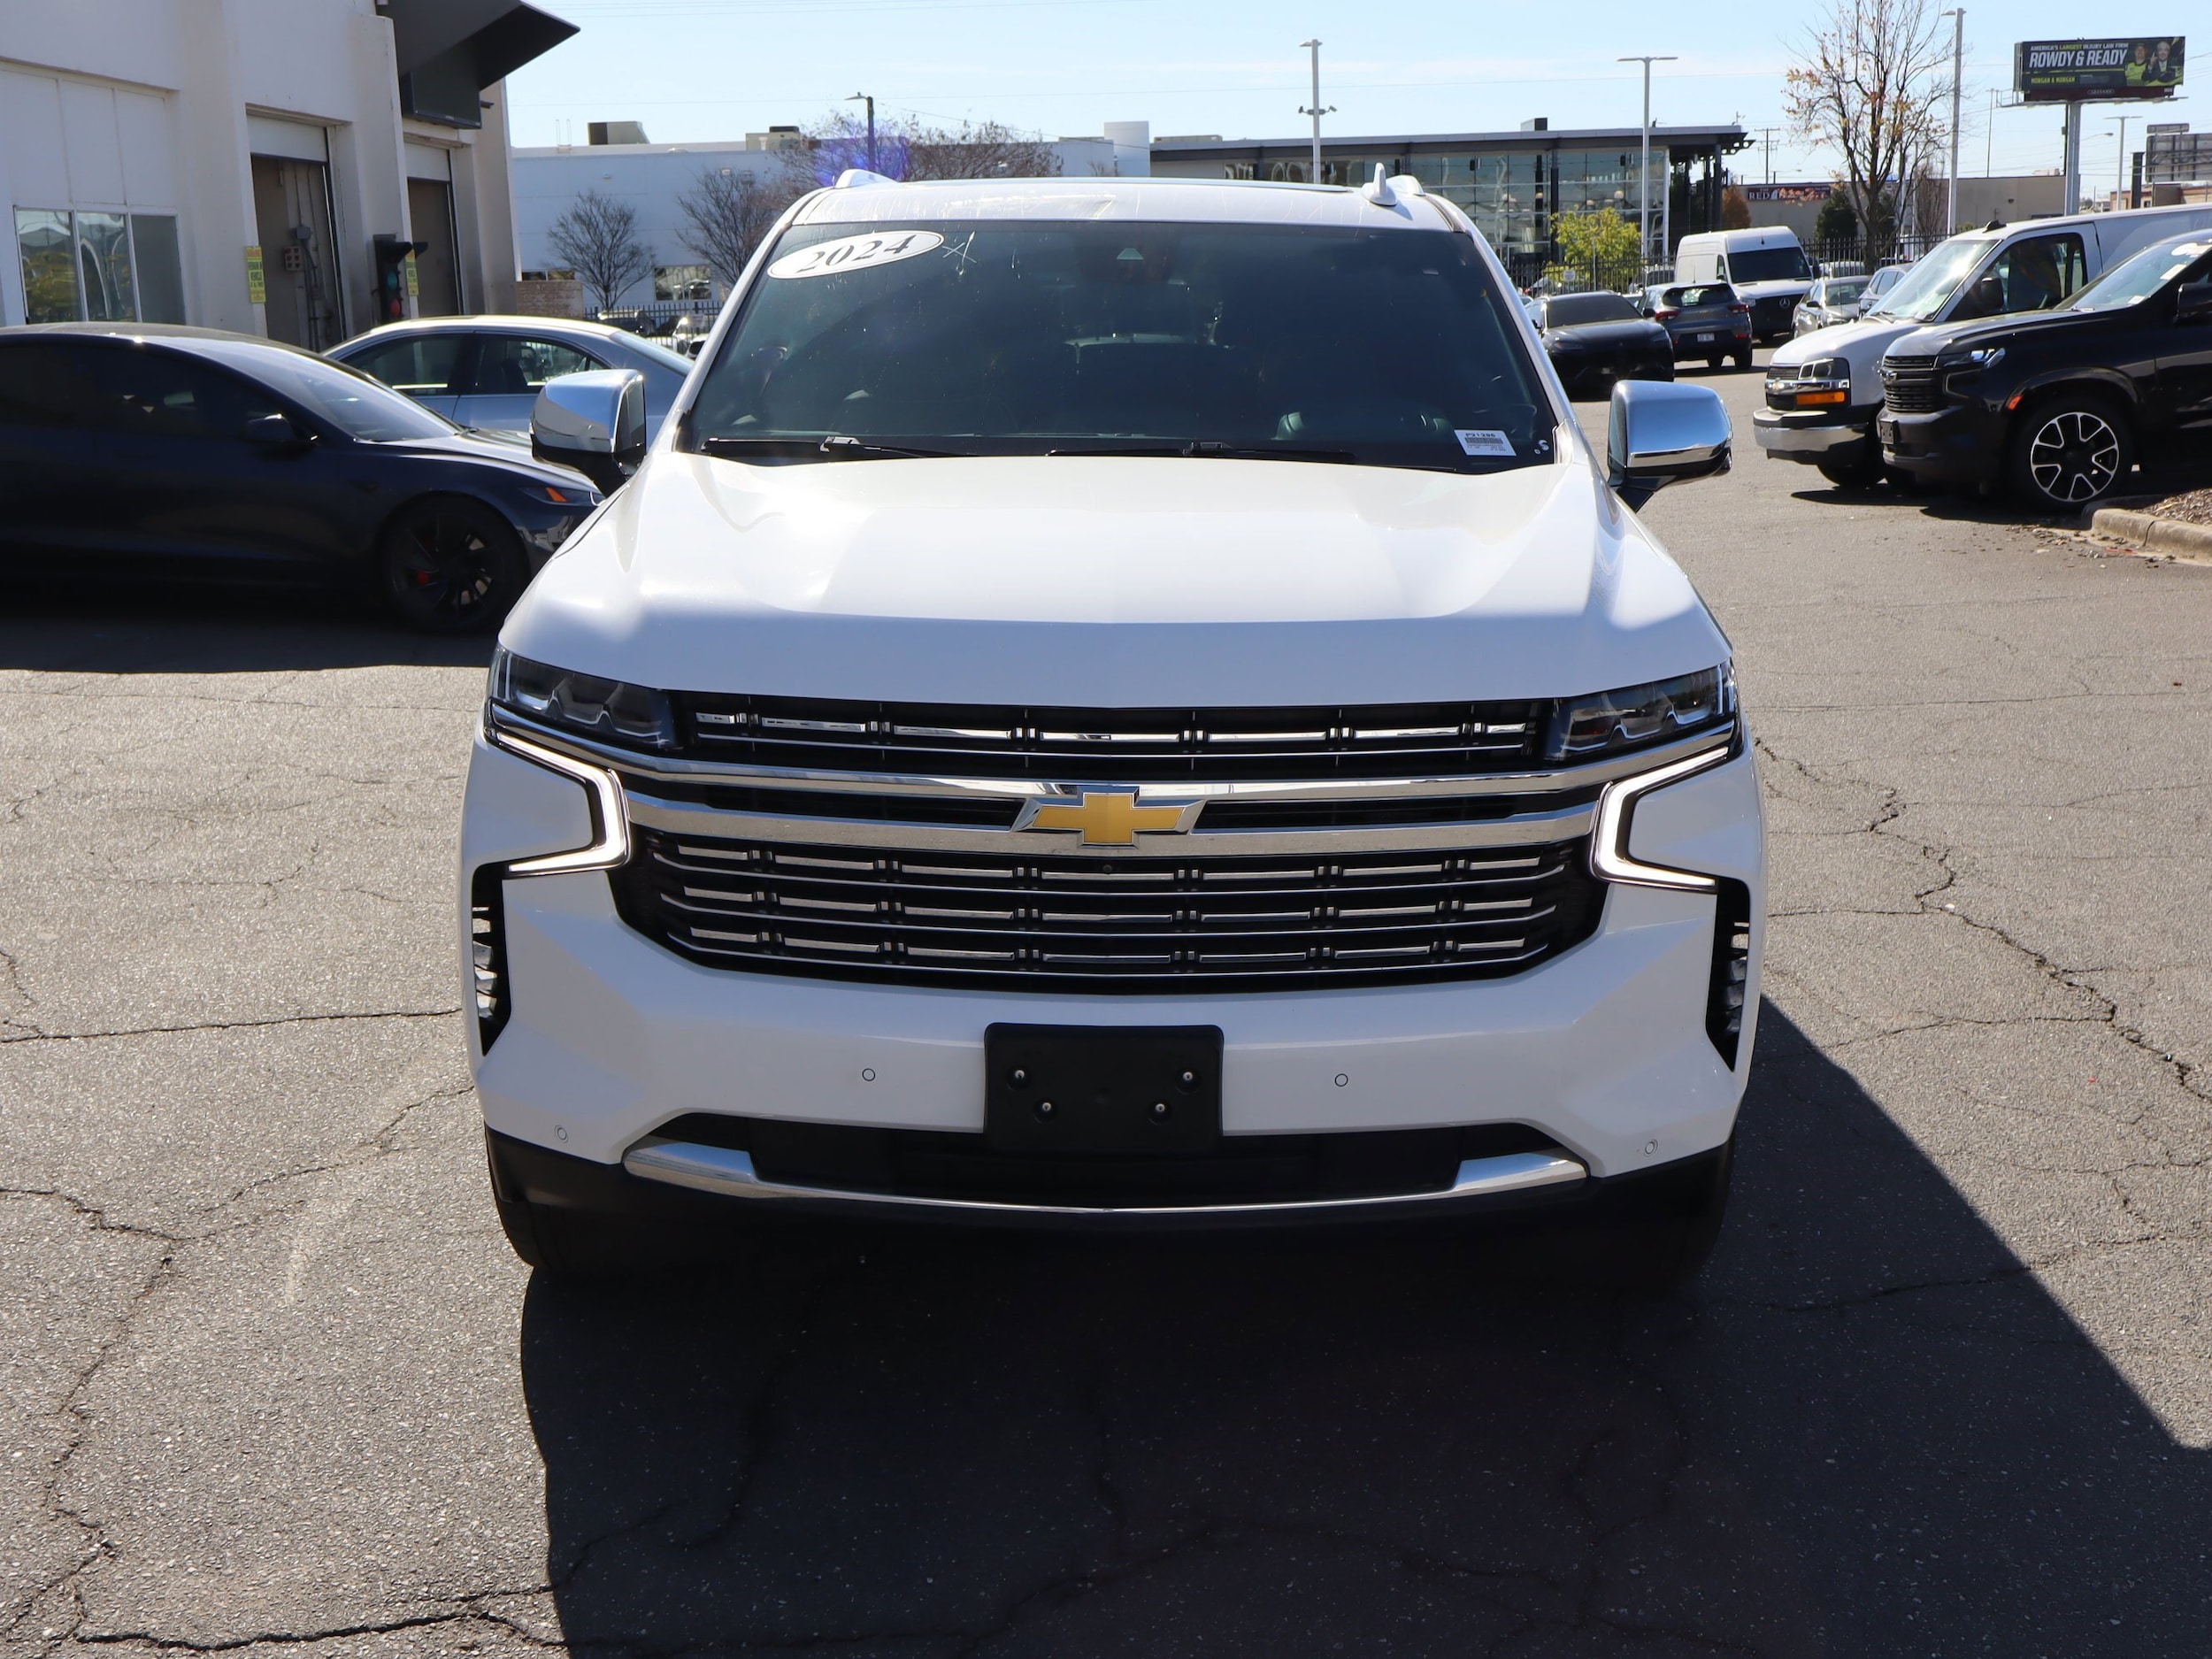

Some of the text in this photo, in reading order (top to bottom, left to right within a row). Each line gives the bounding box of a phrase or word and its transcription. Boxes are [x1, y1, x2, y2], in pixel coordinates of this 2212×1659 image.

[2029, 49, 2128, 68] ROWDY & READY
[1748, 191, 1770, 200] RED
[796, 234, 917, 273] 2024
